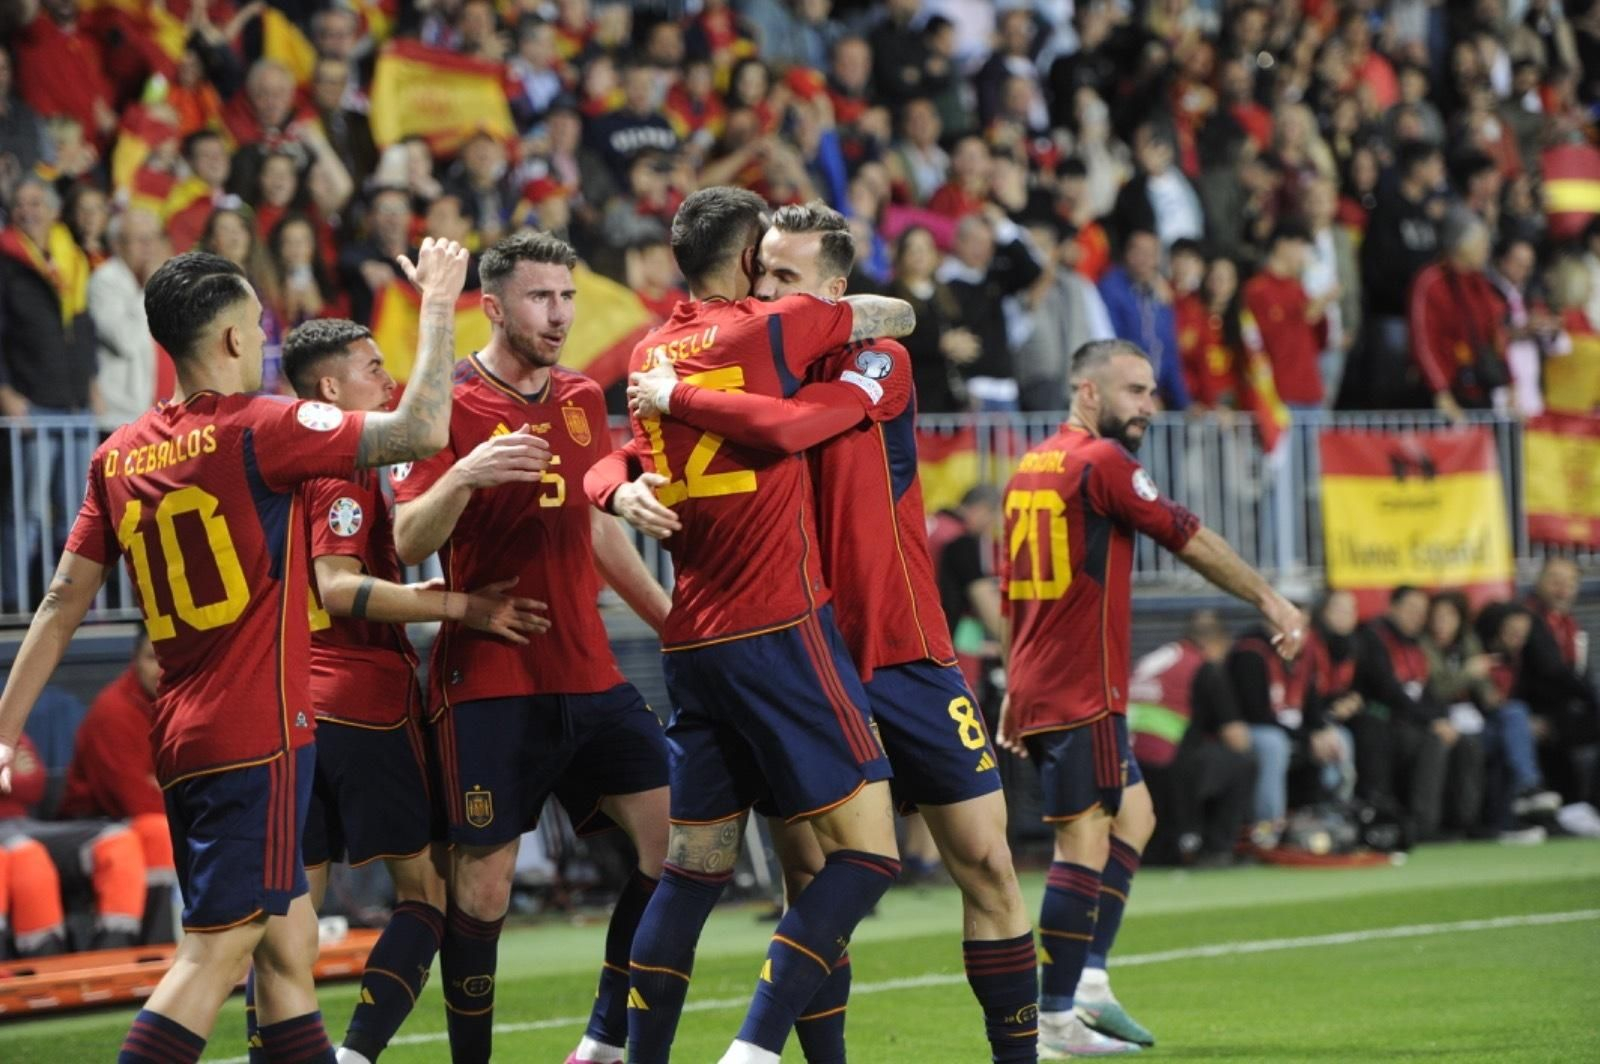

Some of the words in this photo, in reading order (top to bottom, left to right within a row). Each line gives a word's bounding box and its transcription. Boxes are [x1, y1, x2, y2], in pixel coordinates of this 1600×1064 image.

[124, 424, 217, 477] CEBALLOS
[118, 486, 251, 642] 10
[1006, 489, 1072, 600] 20
[948, 695, 986, 750] 8
